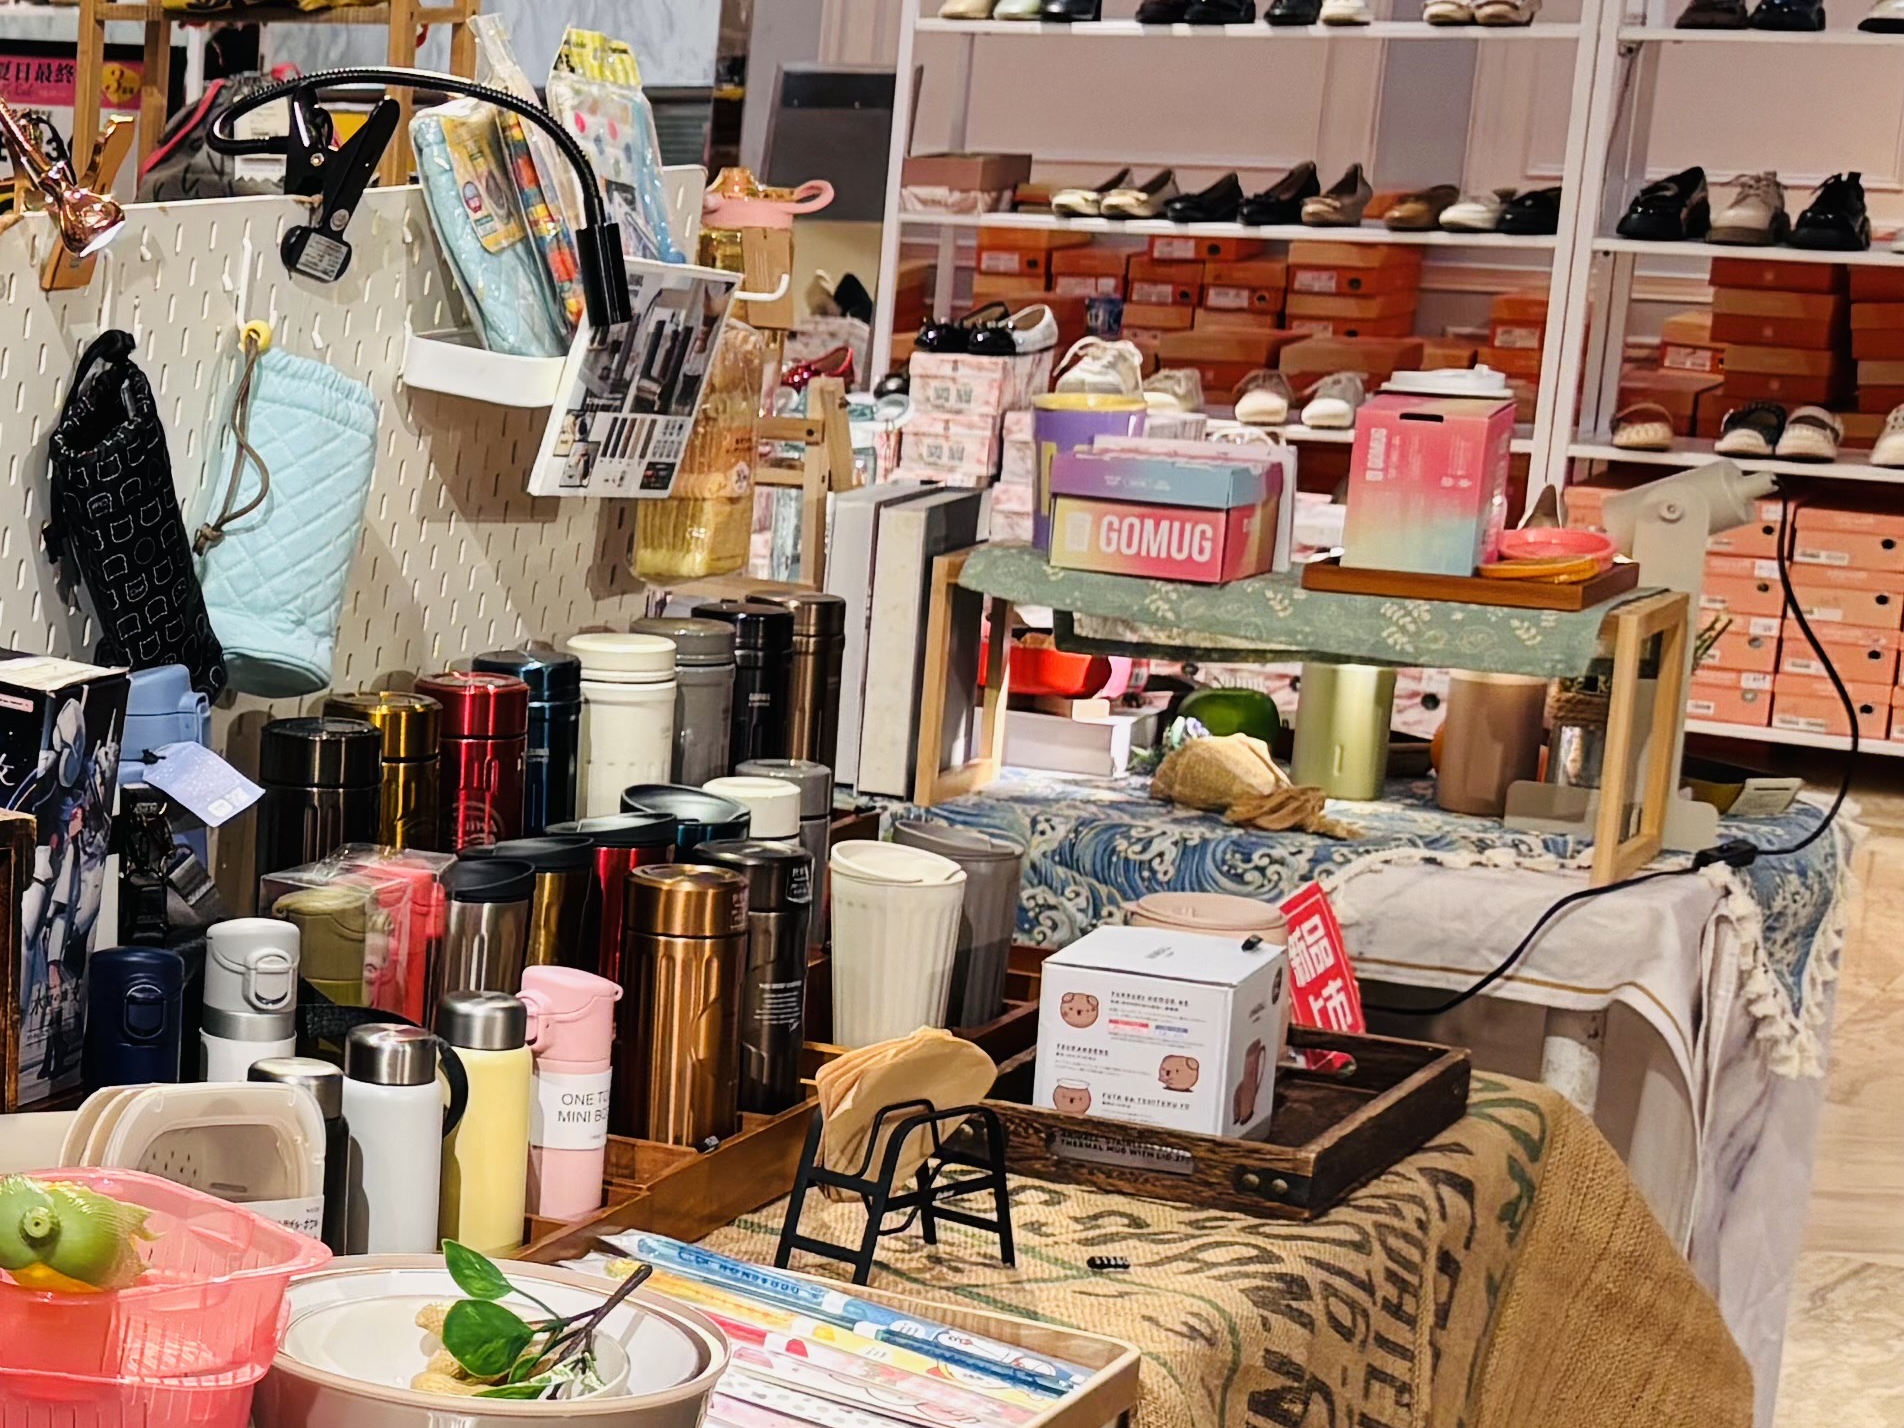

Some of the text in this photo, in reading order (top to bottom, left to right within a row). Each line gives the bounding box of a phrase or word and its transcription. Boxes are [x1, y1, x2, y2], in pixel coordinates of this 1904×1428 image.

[1097, 514, 1213, 564] GOMUG
[1288, 915, 1335, 989] 新品
[1307, 979, 1354, 1033] 上市
[557, 1109, 592, 1124] MINI
[561, 1091, 594, 1106] ONE
